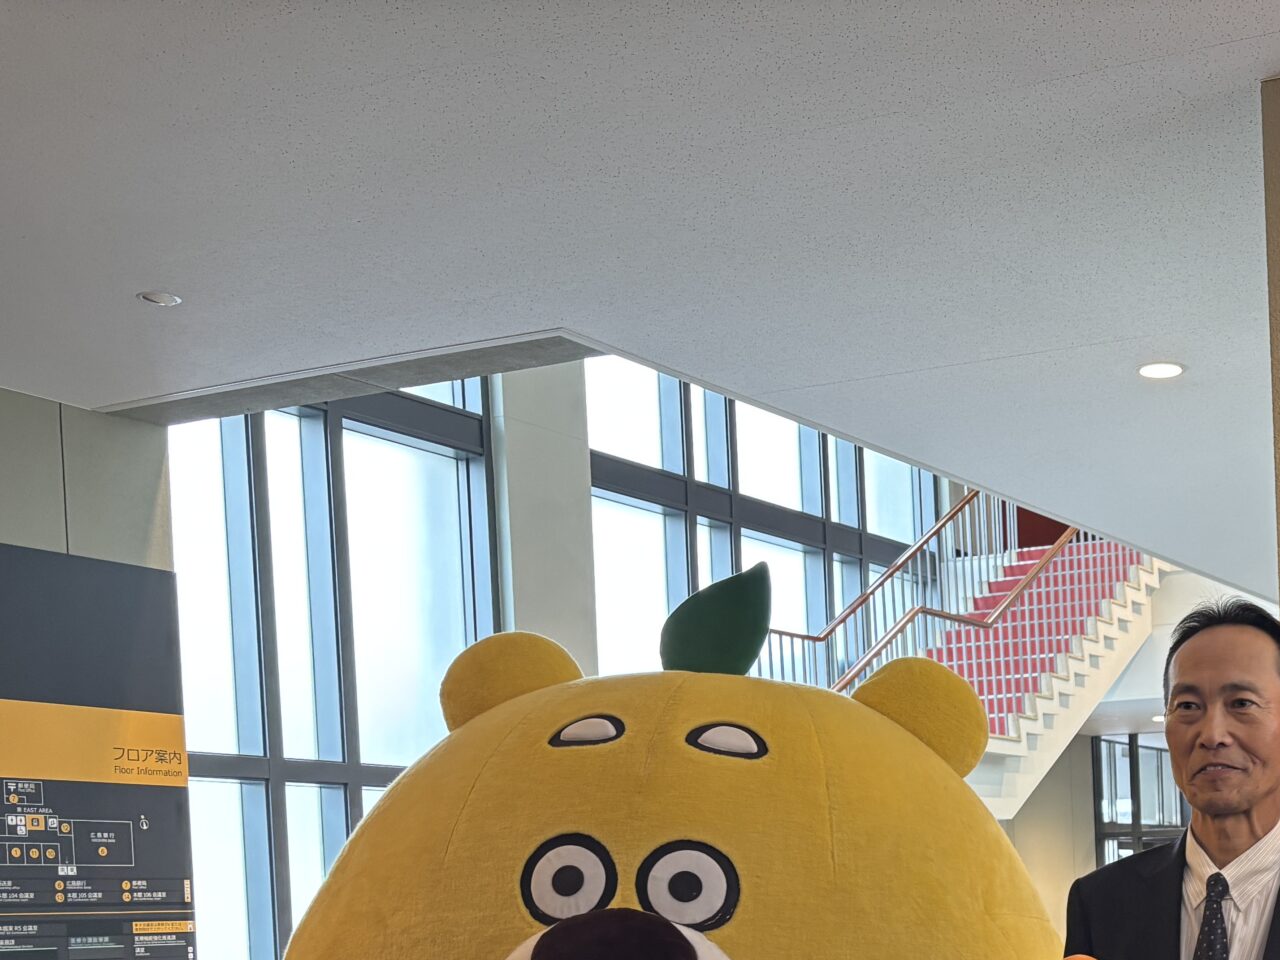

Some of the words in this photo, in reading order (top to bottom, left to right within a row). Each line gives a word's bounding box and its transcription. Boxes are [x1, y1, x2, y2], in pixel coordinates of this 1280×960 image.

[113, 747, 182, 764] フロア案内
[114, 765, 134, 775] Floor
[137, 766, 182, 777] Information
